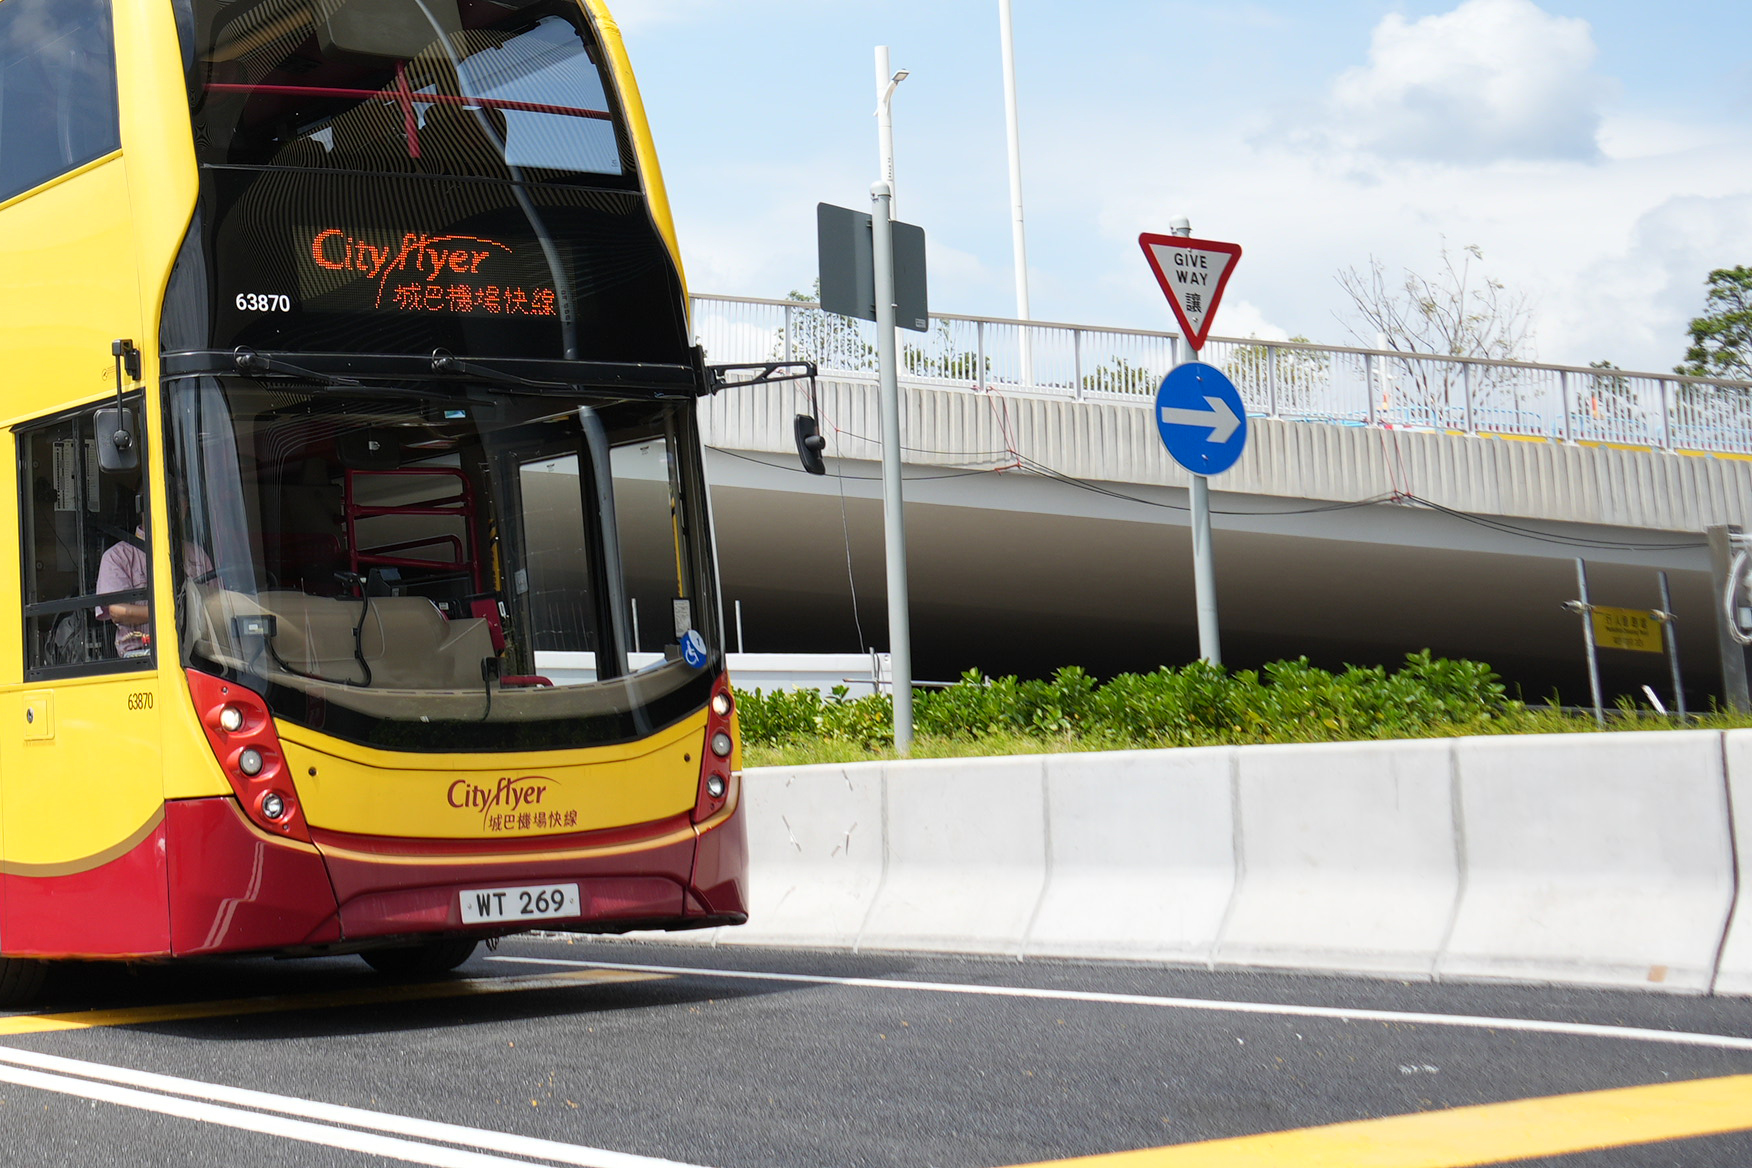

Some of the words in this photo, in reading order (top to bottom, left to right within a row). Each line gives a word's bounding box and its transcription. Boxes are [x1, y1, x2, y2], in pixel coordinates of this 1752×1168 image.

[1174, 253, 1208, 269] GIVE
[1176, 270, 1208, 286] WAY
[235, 293, 290, 312] 63870
[392, 283, 556, 316] 城巴機場快線
[1185, 292, 1202, 313] 讓
[127, 692, 154, 710] 63870
[488, 809, 578, 832] 城巴機場快線
[476, 892, 506, 917] WT
[519, 889, 565, 914] 269
